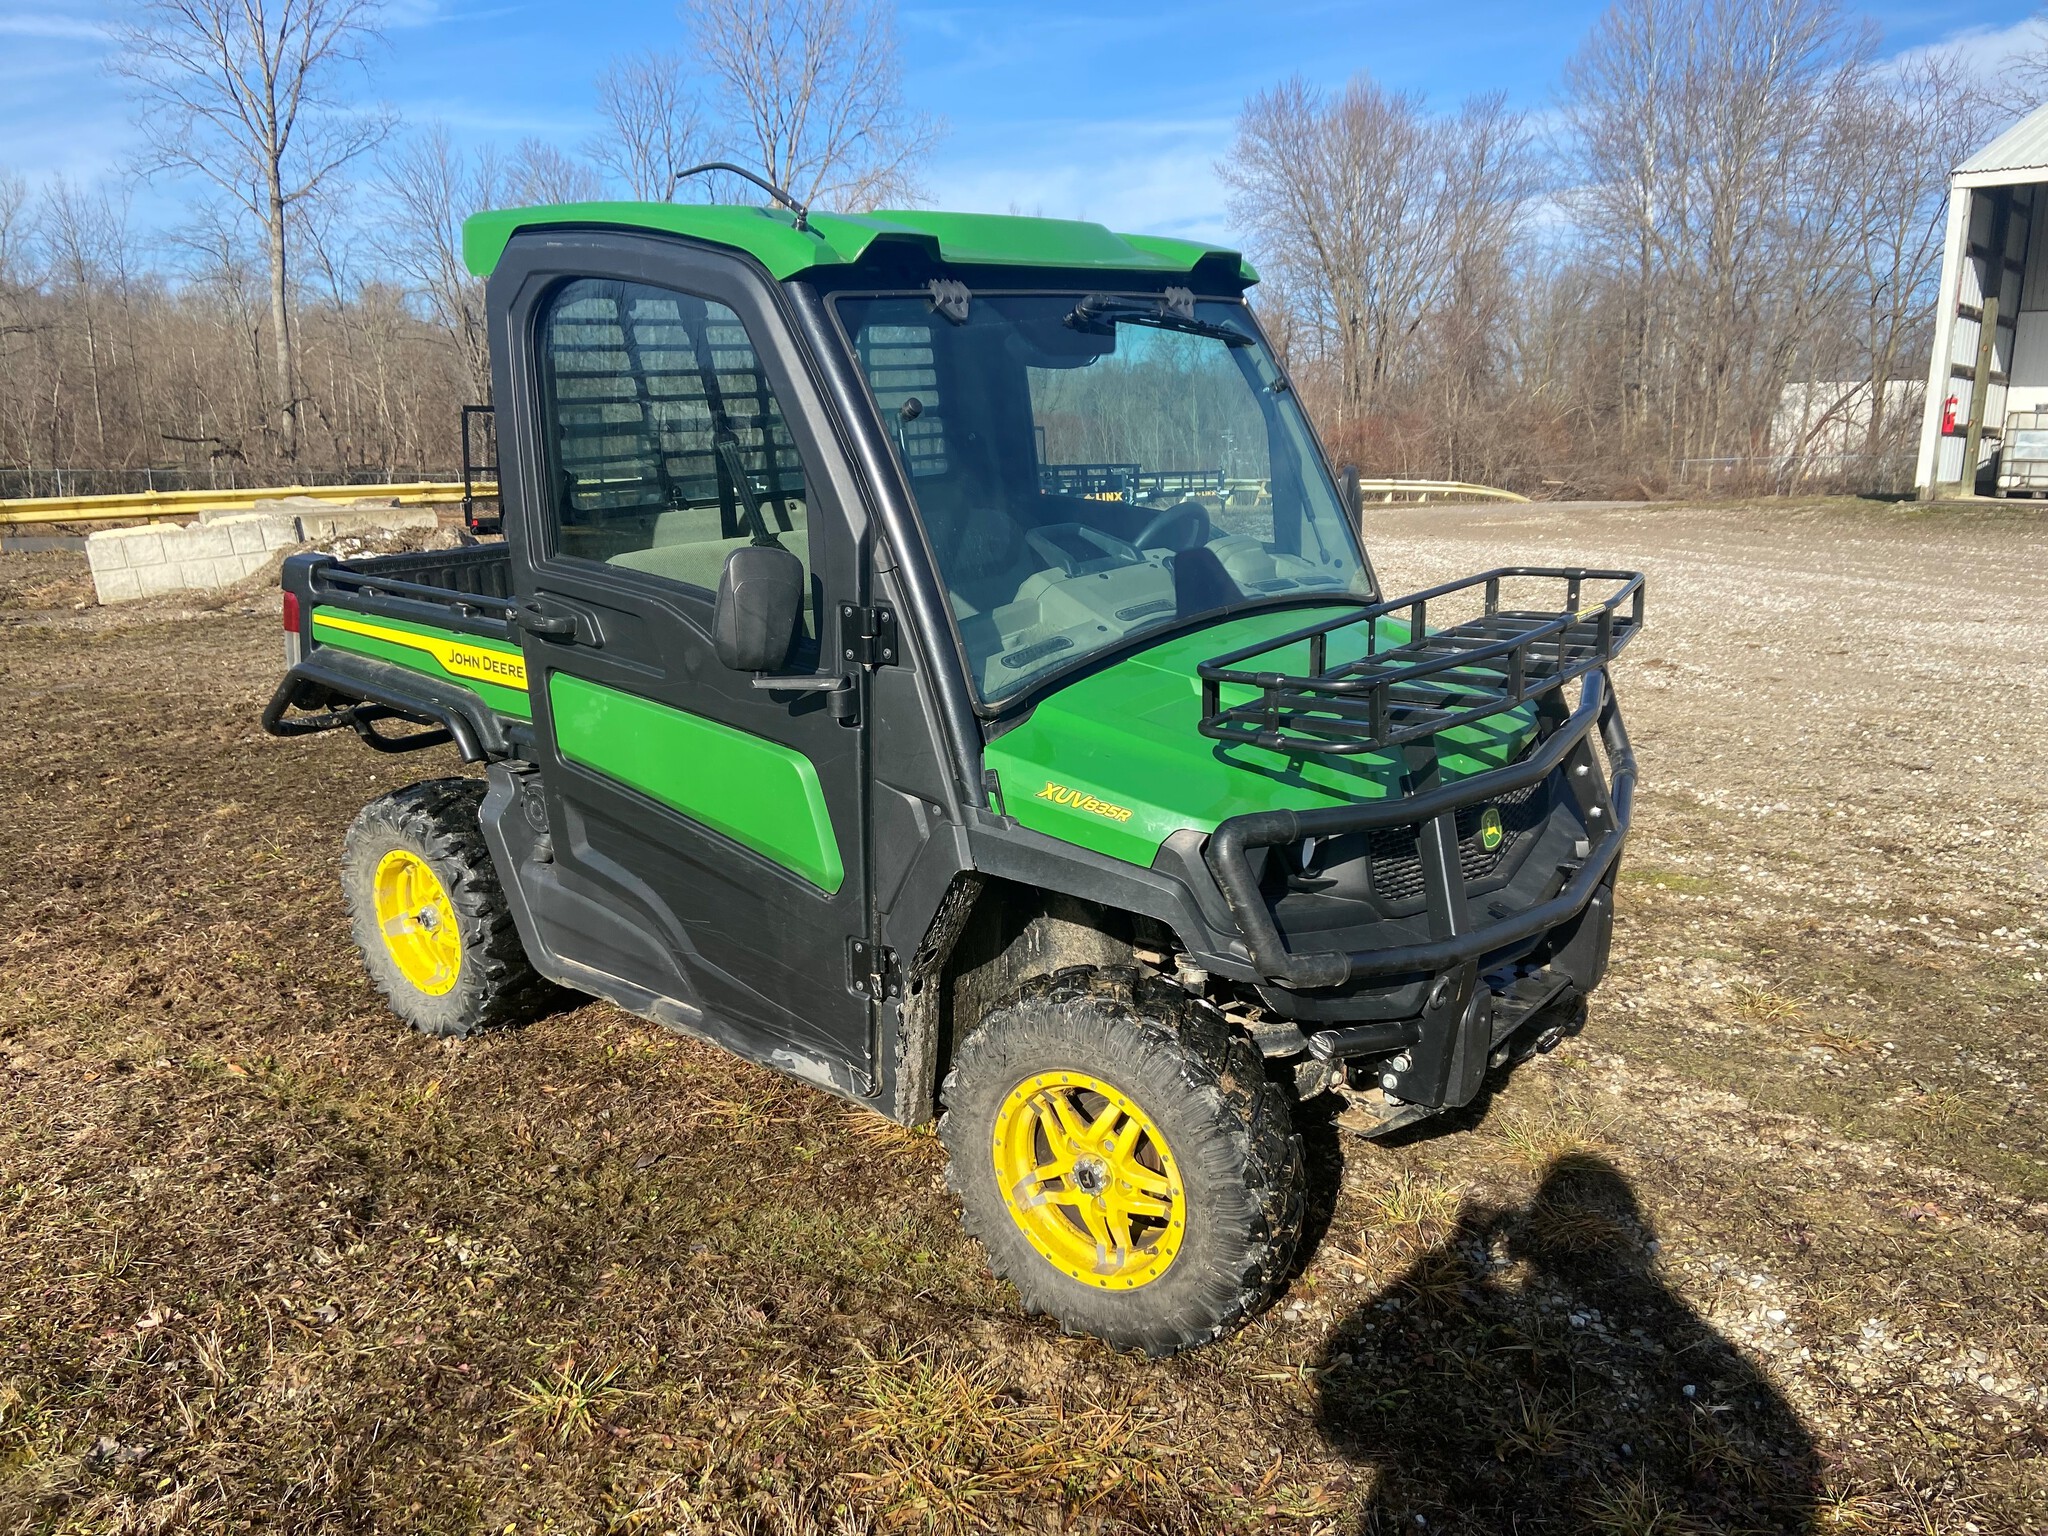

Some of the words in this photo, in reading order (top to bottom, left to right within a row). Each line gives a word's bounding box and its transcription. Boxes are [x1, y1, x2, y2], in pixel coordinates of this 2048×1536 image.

[1095, 491, 1123, 502] LINX
[448, 649, 480, 669] JOHN
[482, 656, 525, 679] DEERE
[1035, 781, 1133, 823] XUV835R
